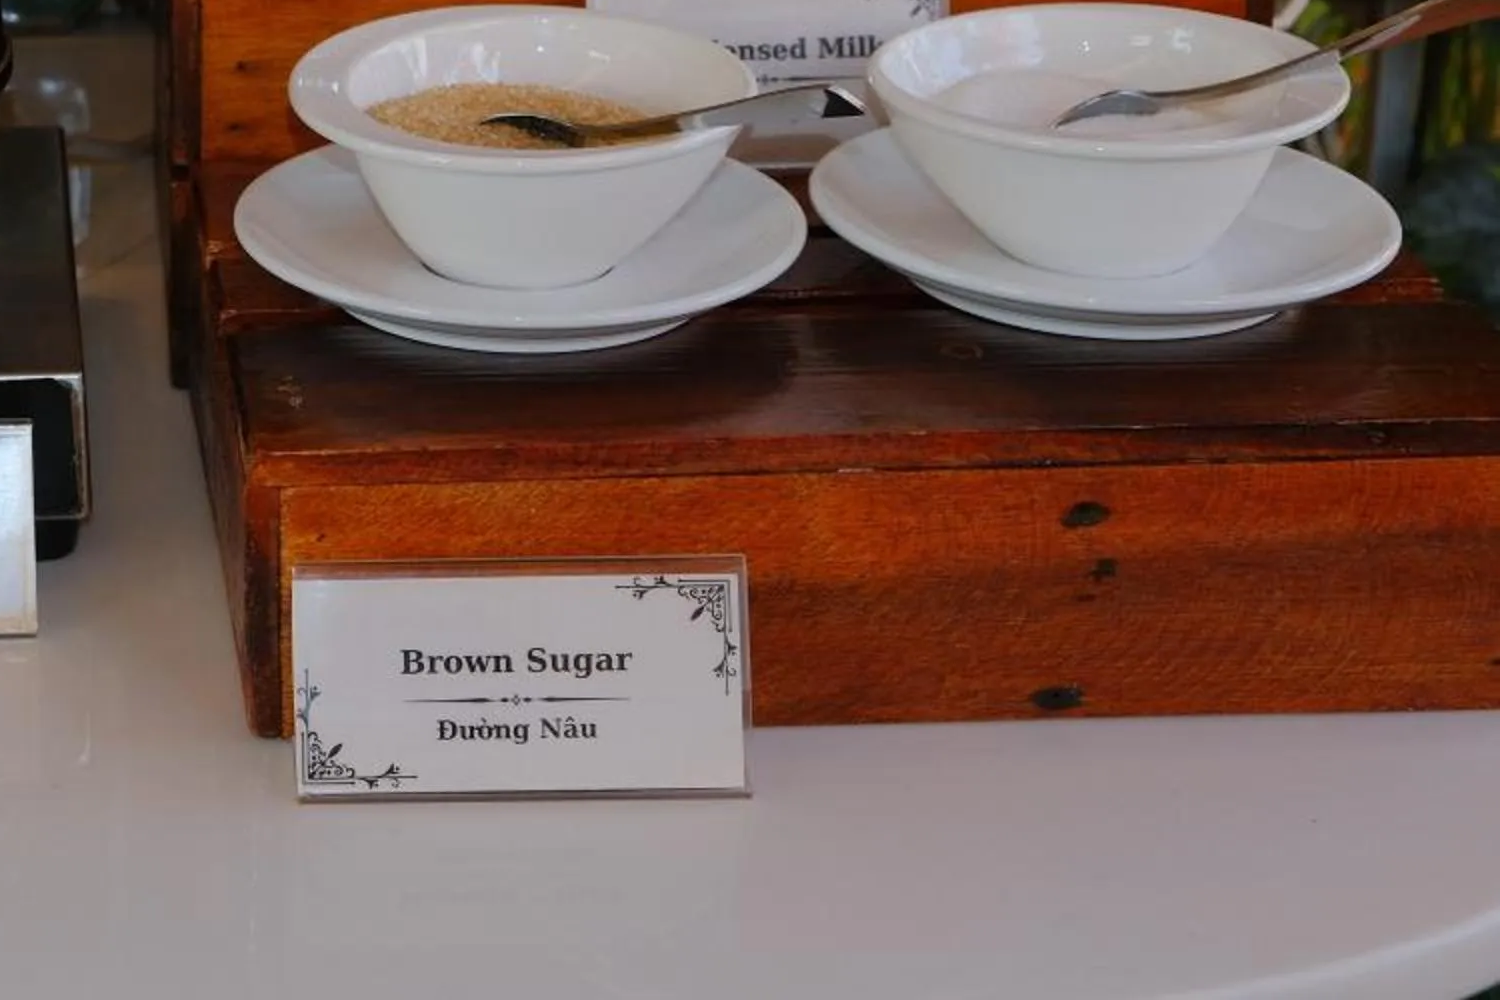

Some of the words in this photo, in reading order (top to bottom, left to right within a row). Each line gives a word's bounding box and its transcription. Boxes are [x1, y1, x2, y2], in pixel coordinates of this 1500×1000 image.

[400, 648, 514, 675] Brown
[527, 647, 633, 679] Sugar
[436, 718, 530, 745] Đường
[540, 716, 598, 740] Nâu
